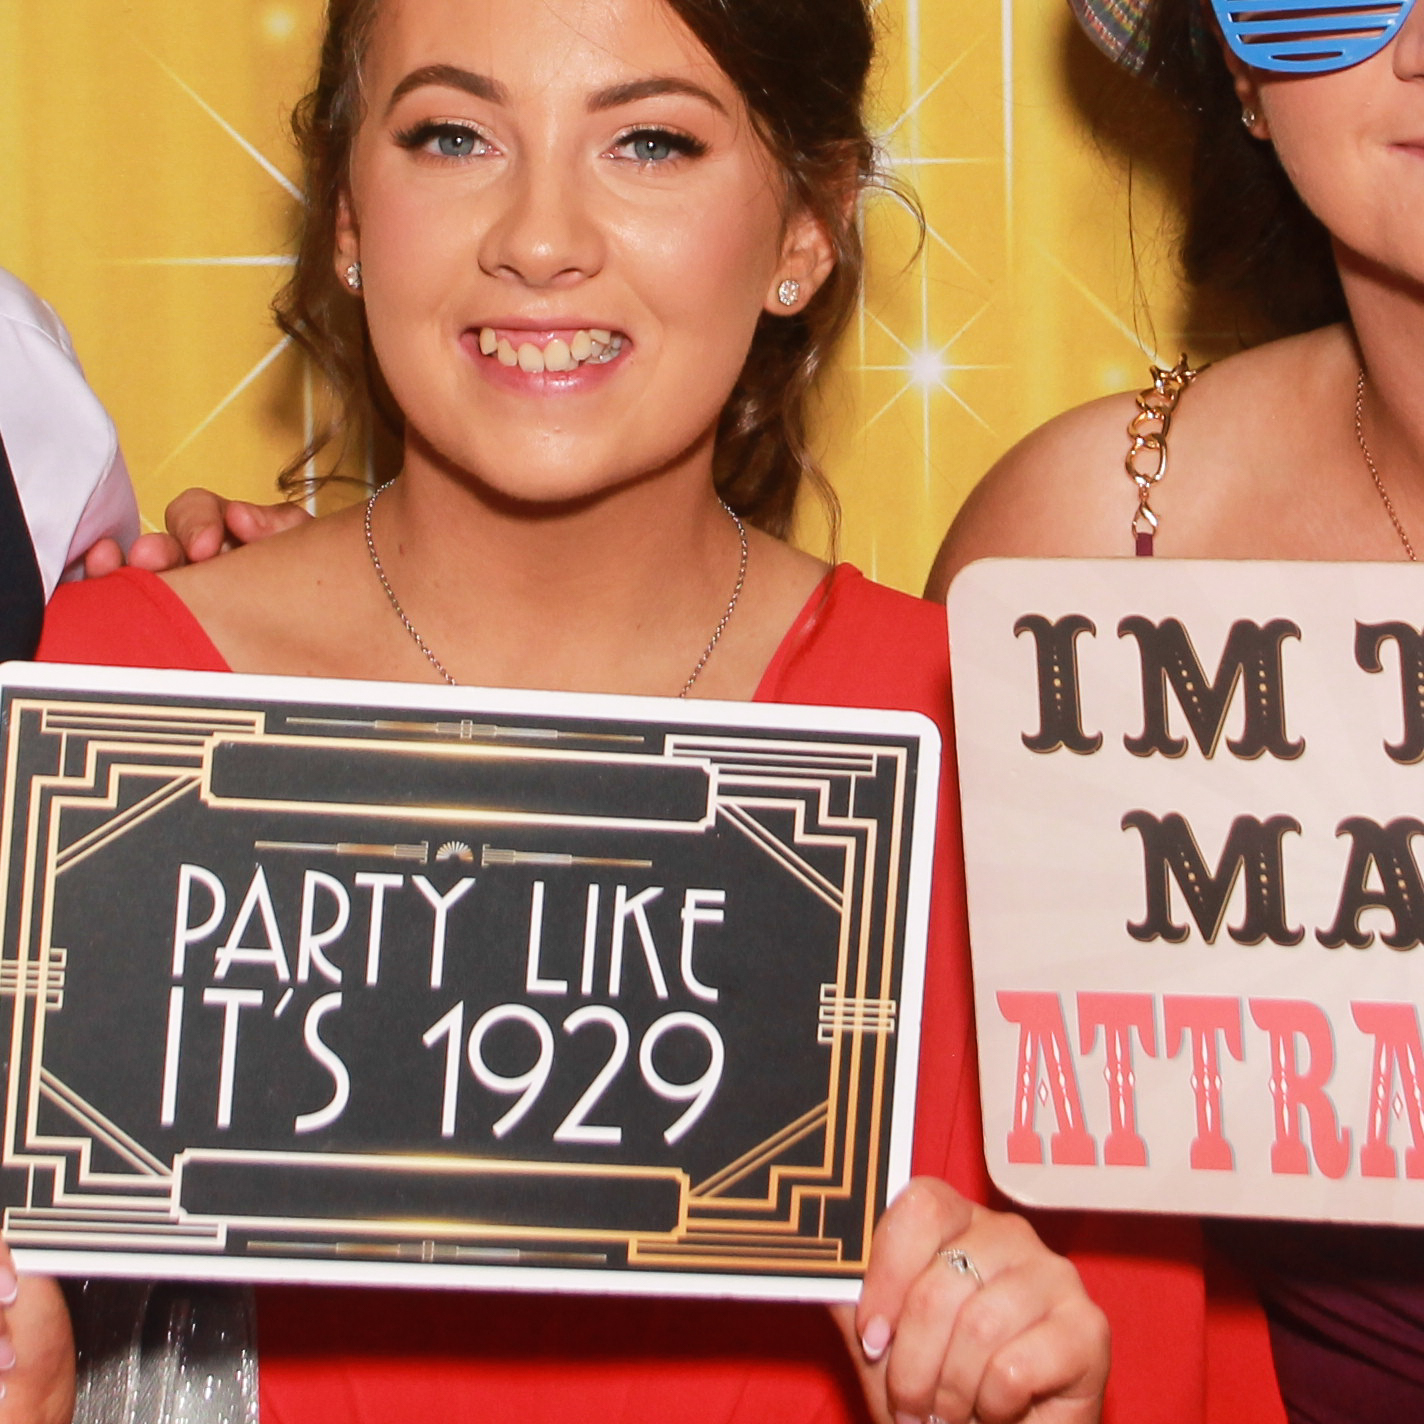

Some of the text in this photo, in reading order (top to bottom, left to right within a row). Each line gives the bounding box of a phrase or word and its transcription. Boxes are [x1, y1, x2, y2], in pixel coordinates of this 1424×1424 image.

[1012, 613, 1306, 760] IM
[172, 863, 726, 1001] PARTY LIKE
[160, 986, 725, 1145] IT'S 1929
